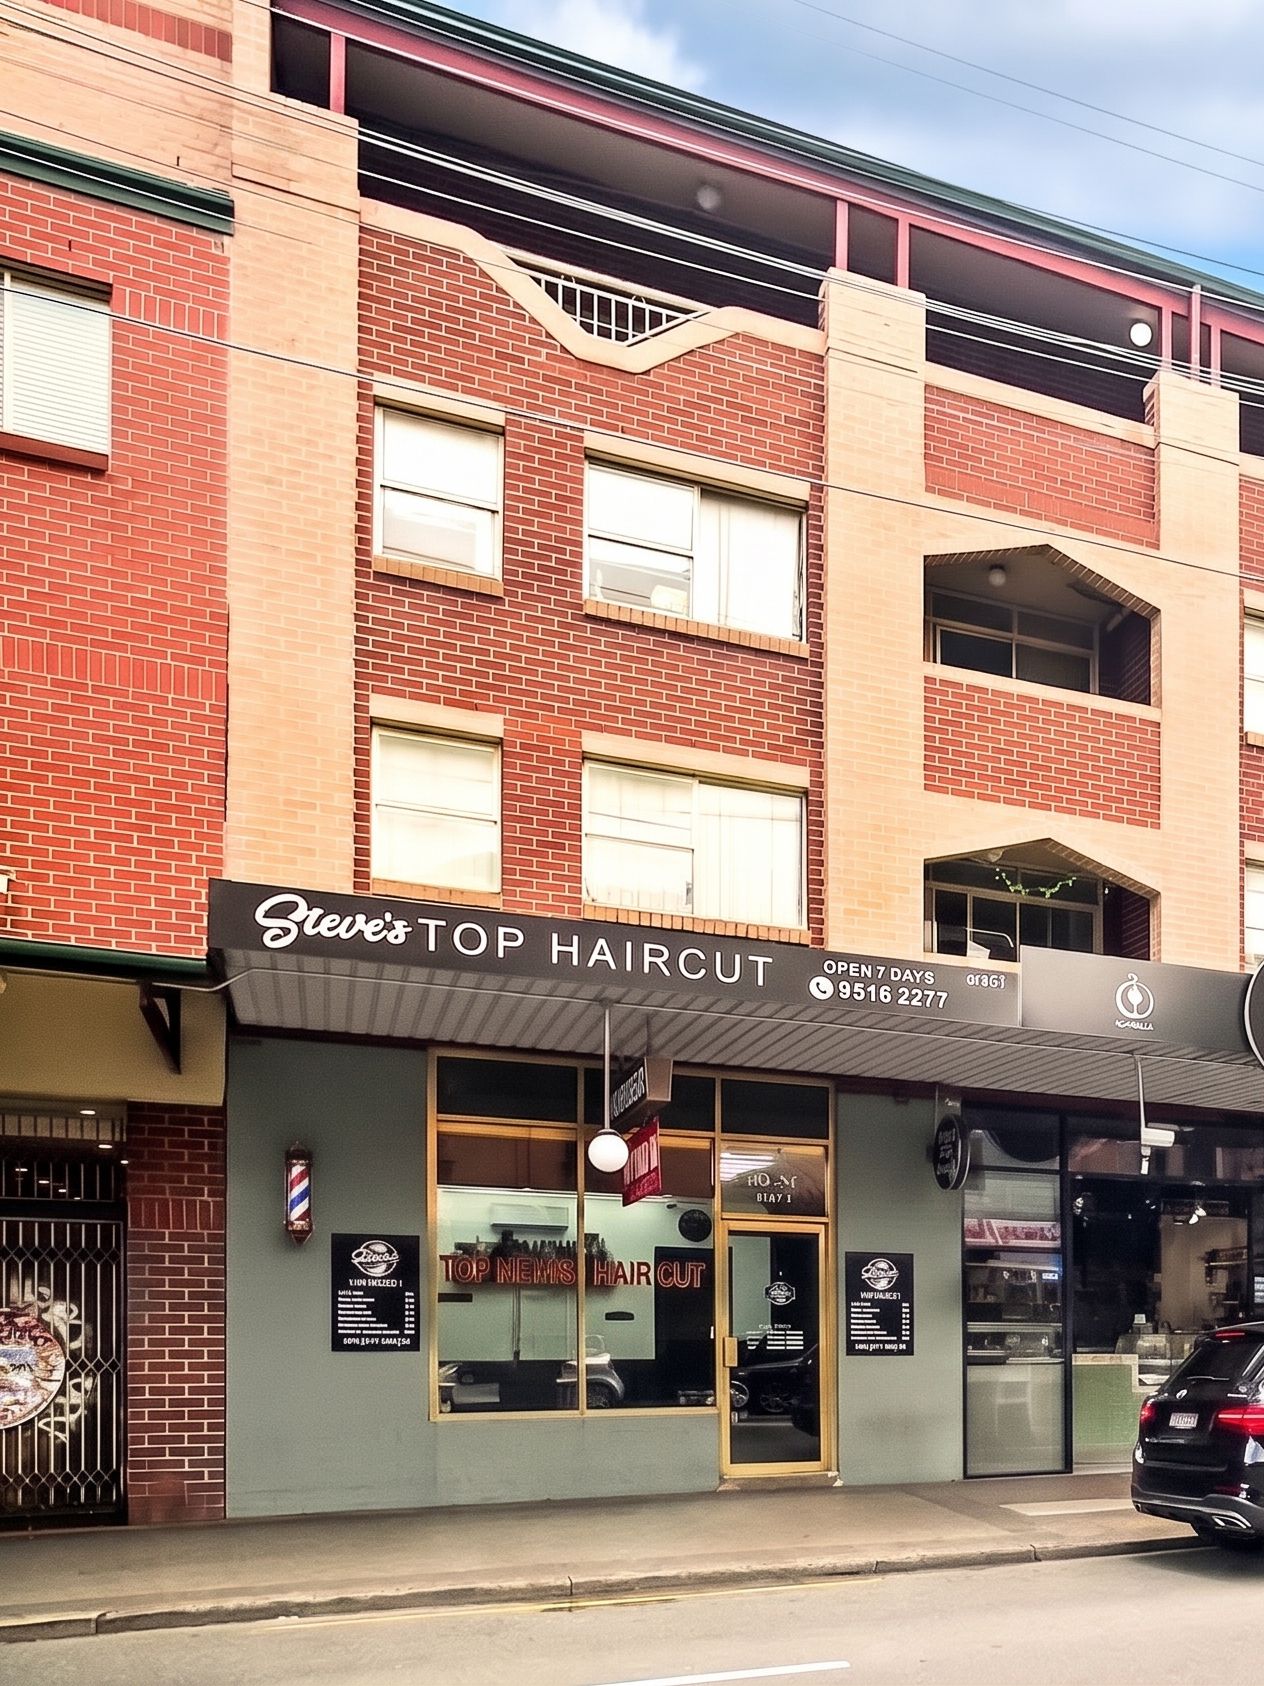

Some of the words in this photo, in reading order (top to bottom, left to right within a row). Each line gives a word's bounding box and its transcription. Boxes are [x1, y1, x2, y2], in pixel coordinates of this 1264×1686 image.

[254, 893, 413, 949] Steve's
[417, 917, 525, 958] TOP
[551, 932, 773, 987] HAIRCUT
[823, 960, 873, 979] OPEN
[876, 966, 886, 979] 7
[890, 968, 935, 985] DAYS
[838, 981, 892, 1003] 9516
[897, 987, 949, 1009] 2277
[439, 1255, 490, 1283] TOP
[594, 1258, 652, 1286] HAIR
[657, 1260, 705, 1288] CUT
